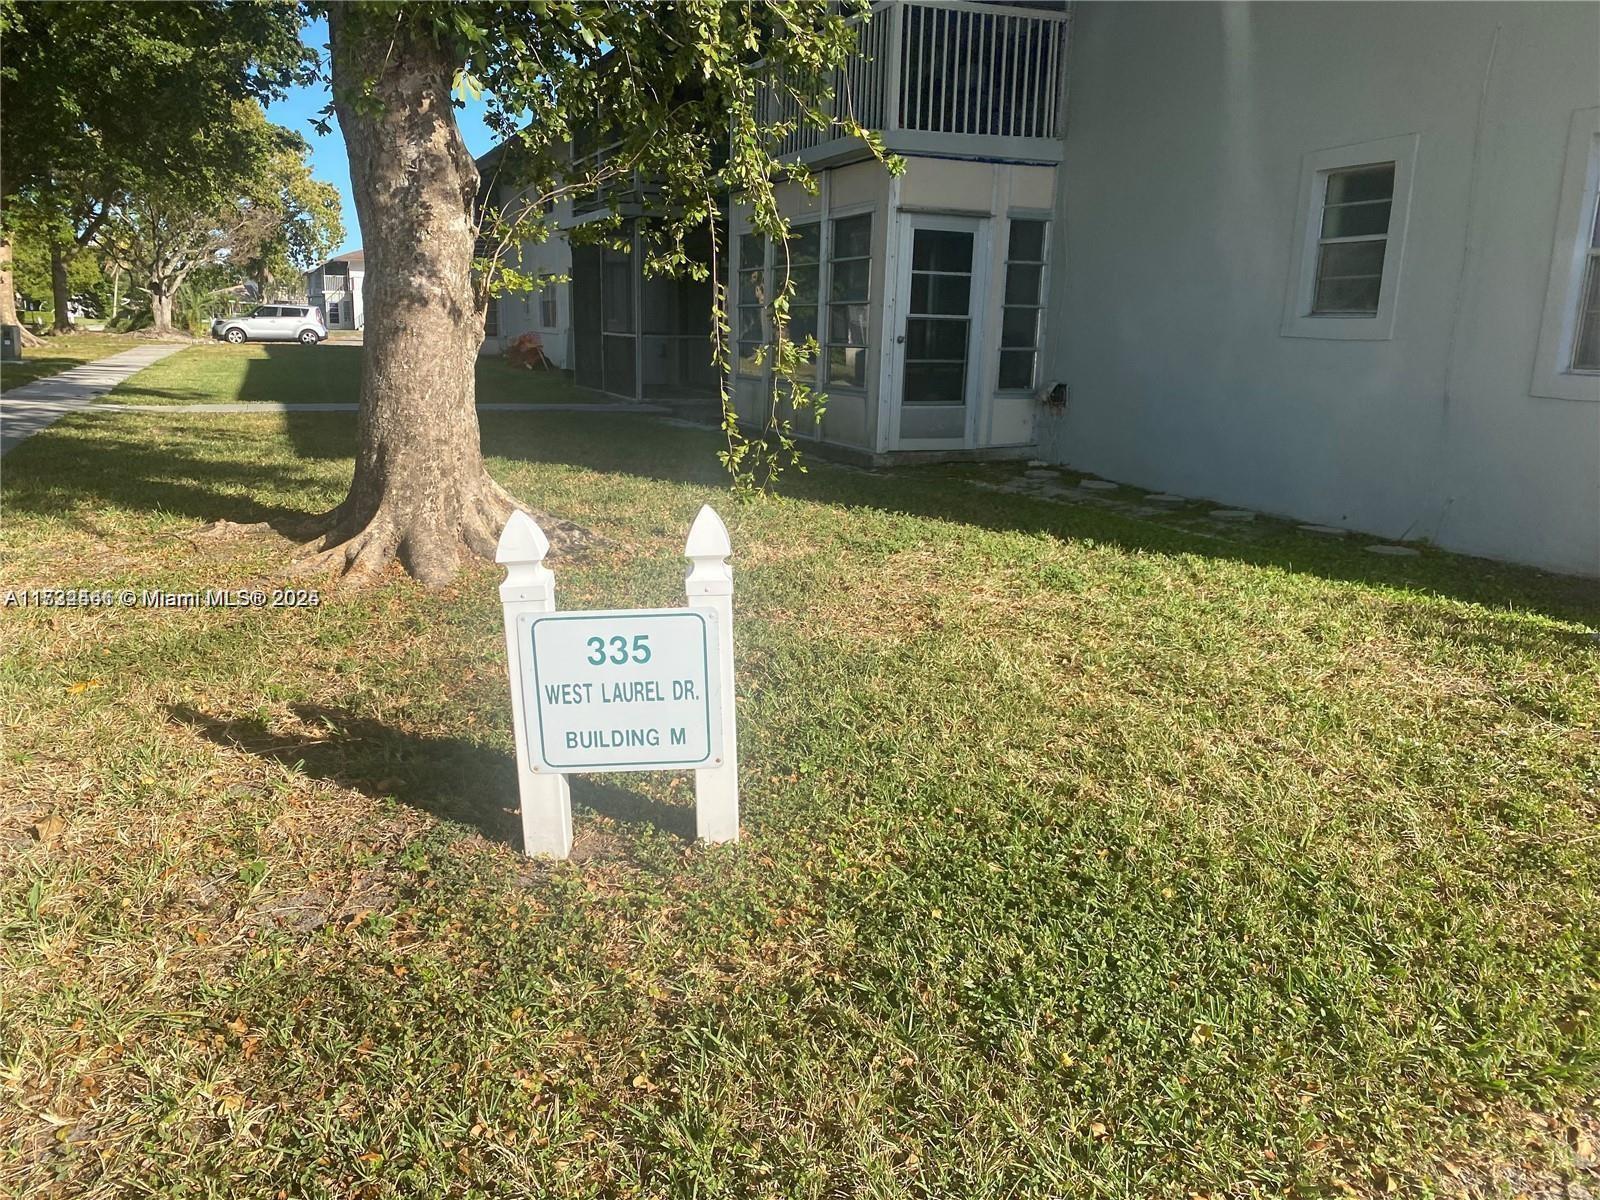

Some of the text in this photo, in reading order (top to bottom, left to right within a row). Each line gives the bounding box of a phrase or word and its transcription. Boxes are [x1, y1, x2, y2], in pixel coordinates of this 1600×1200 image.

[586, 634, 652, 666] 335
[545, 679, 700, 705] WEST LAUREL DR.
[565, 727, 686, 749] BUILDING M
